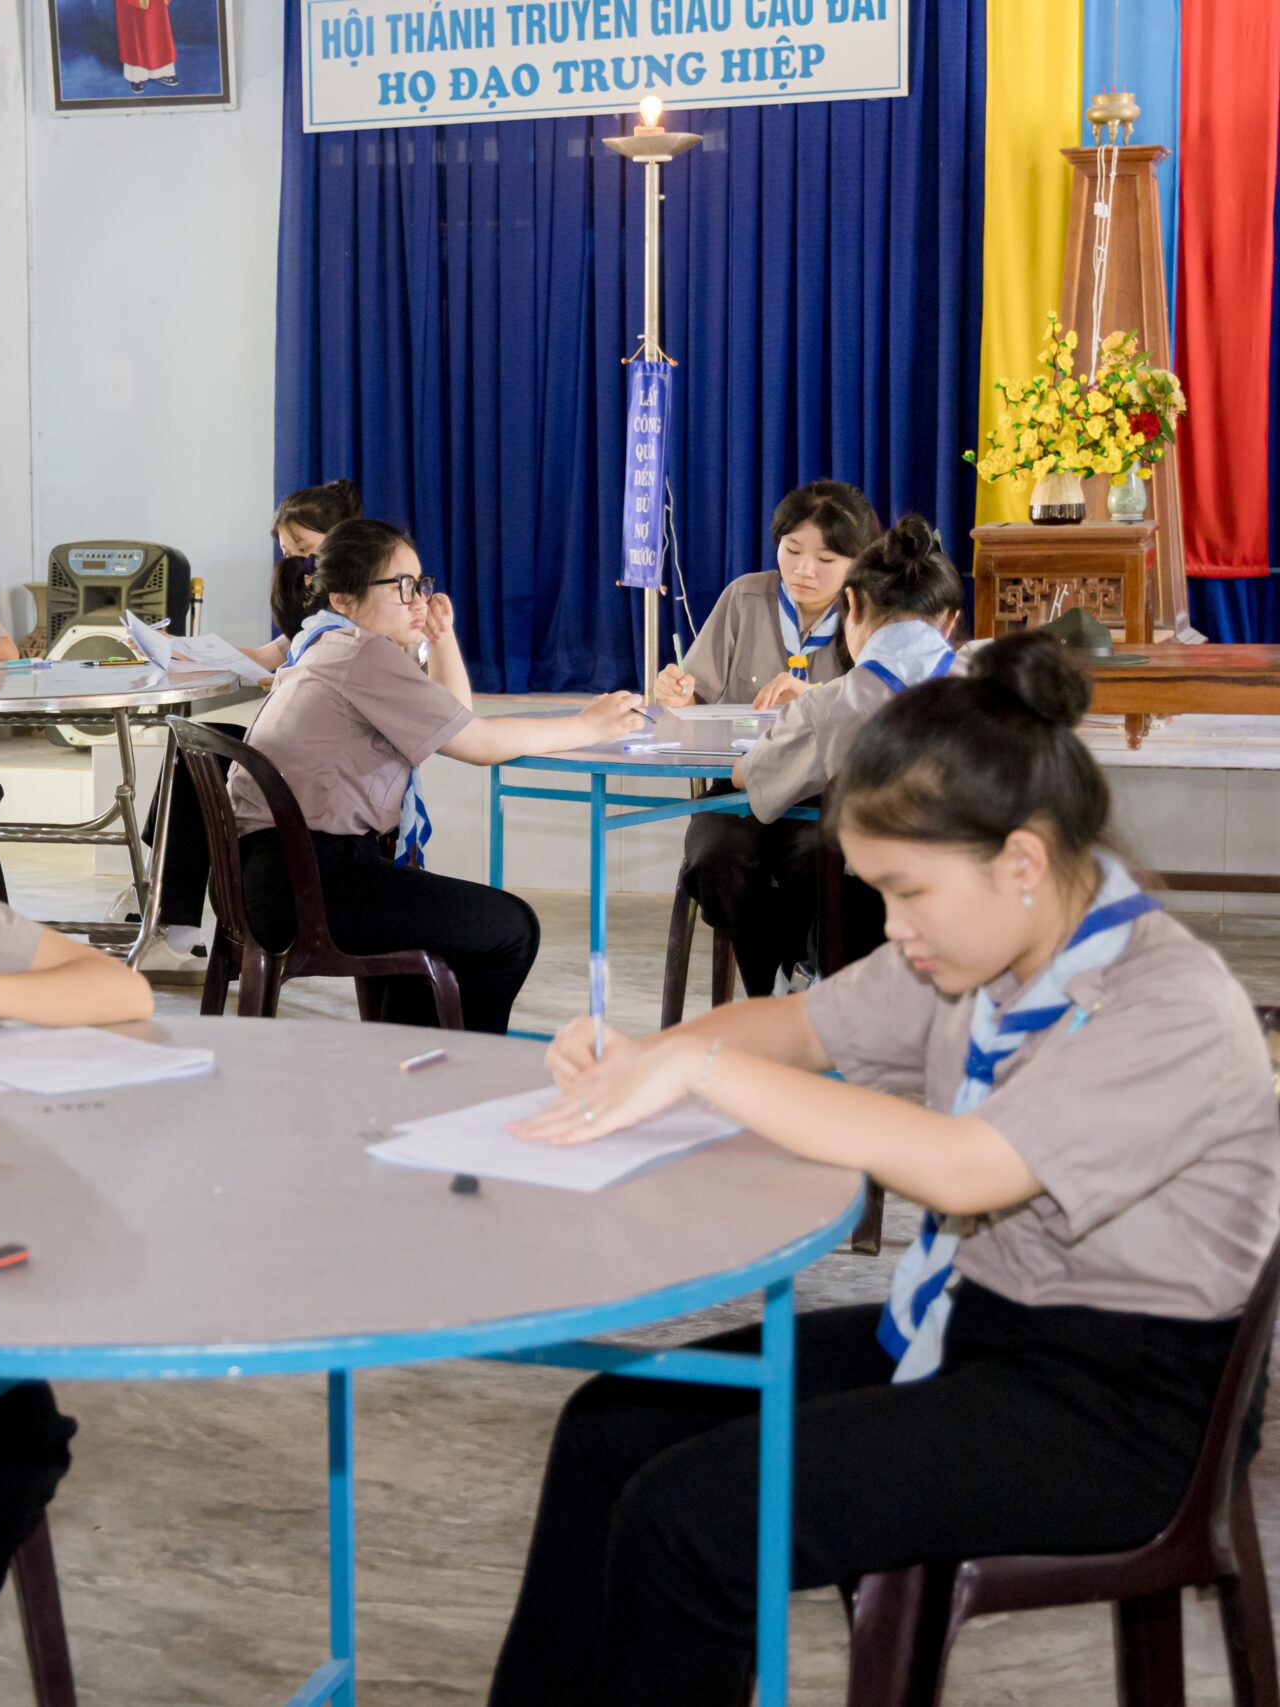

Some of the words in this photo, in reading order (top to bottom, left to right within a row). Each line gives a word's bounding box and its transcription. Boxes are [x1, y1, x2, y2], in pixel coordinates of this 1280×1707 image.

[321, 8, 375, 67] HỘI
[385, 2, 495, 54] THÁNH
[378, 70, 436, 113] HỌ
[449, 63, 539, 108] ĐẠO
[553, 51, 708, 94] TRUNG
[721, 34, 825, 90] HIỆP
[633, 413, 661, 433] CÔNG
[635, 437, 656, 463] QUẢ
[634, 463, 656, 486] ĐỀN
[636, 492, 650, 513] BÙ
[634, 521, 650, 543] NỢ
